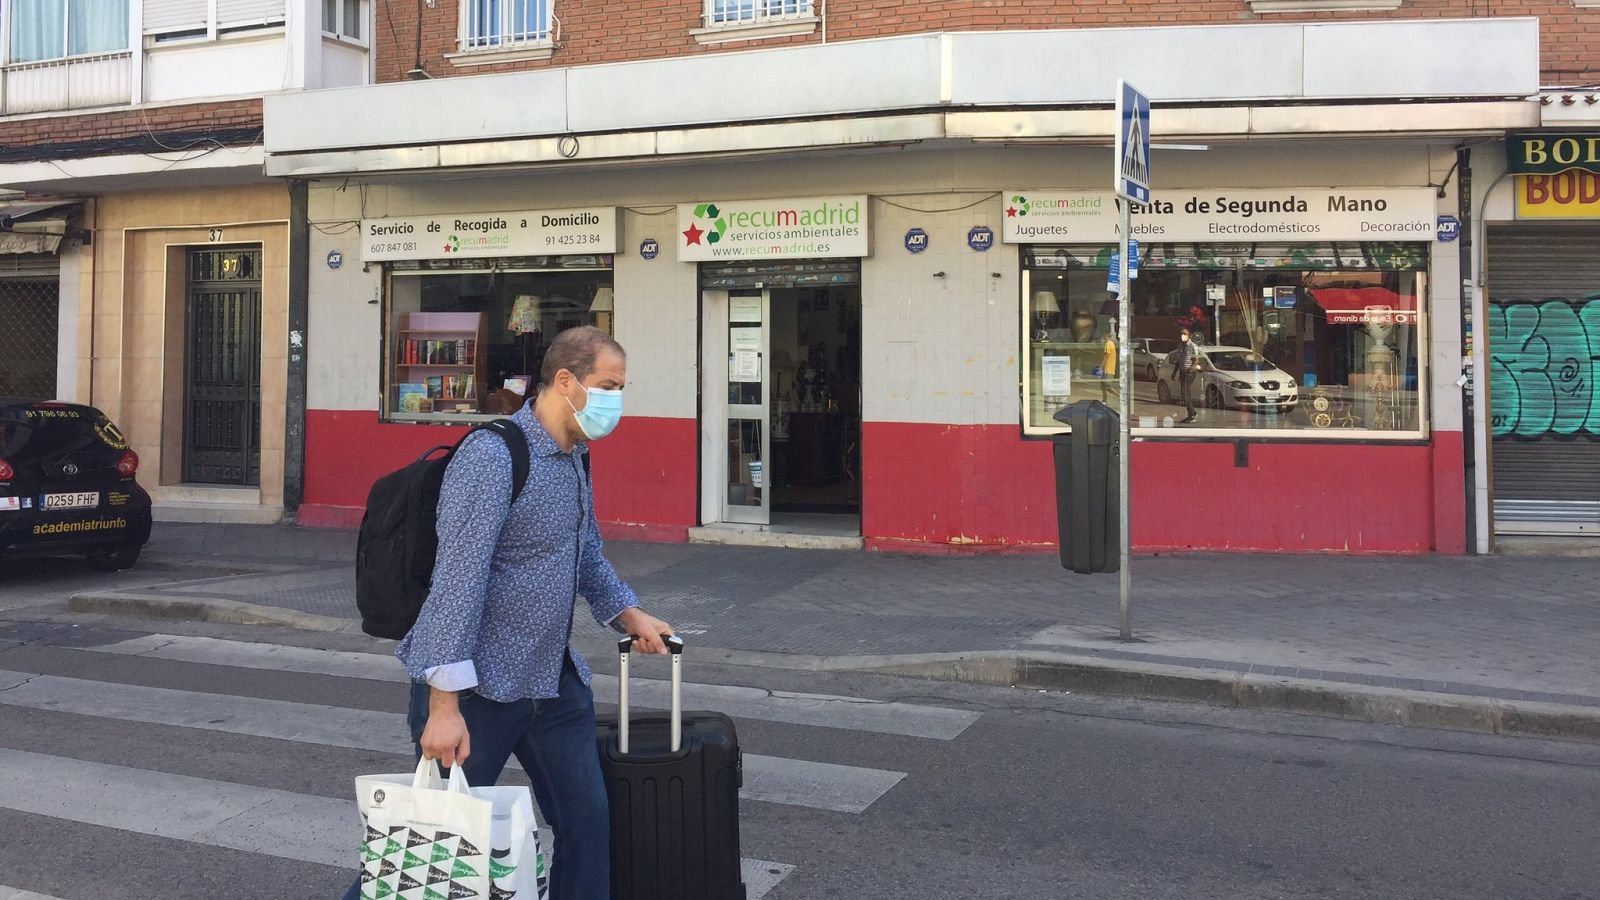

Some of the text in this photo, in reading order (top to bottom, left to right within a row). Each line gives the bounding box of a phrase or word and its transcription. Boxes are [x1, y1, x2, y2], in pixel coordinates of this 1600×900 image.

[1031, 196, 1101, 208] recumadrid
[1184, 197, 1210, 214] de
[1216, 195, 1308, 218] Segunda
[1327, 195, 1387, 212] Mano
[729, 201, 859, 228] recumadrid
[370, 212, 600, 236] Servicio de Recogida a Domicilio
[1016, 224, 1068, 237] Juguetes
[1208, 222, 1320, 234] Electrodomésticos
[1360, 220, 1431, 232] Decoración
[1438, 222, 1457, 233] ADT
[209, 229, 223, 241] 37
[461, 234, 509, 245] recumadrid
[545, 234, 600, 245] 91 425 23 84
[730, 225, 859, 242] servicios ambientales
[908, 234, 925, 245] ADT
[971, 232, 990, 243] ADT
[370, 242, 417, 253] 607 847 081
[642, 243, 657, 252] ADT
[712, 242, 830, 256] www.recumadrid.es
[223, 259, 238, 272] 37
[46, 495, 74, 507] 0259
[76, 493, 97, 505] FHF
[33, 517, 127, 534] academiatriunfo
